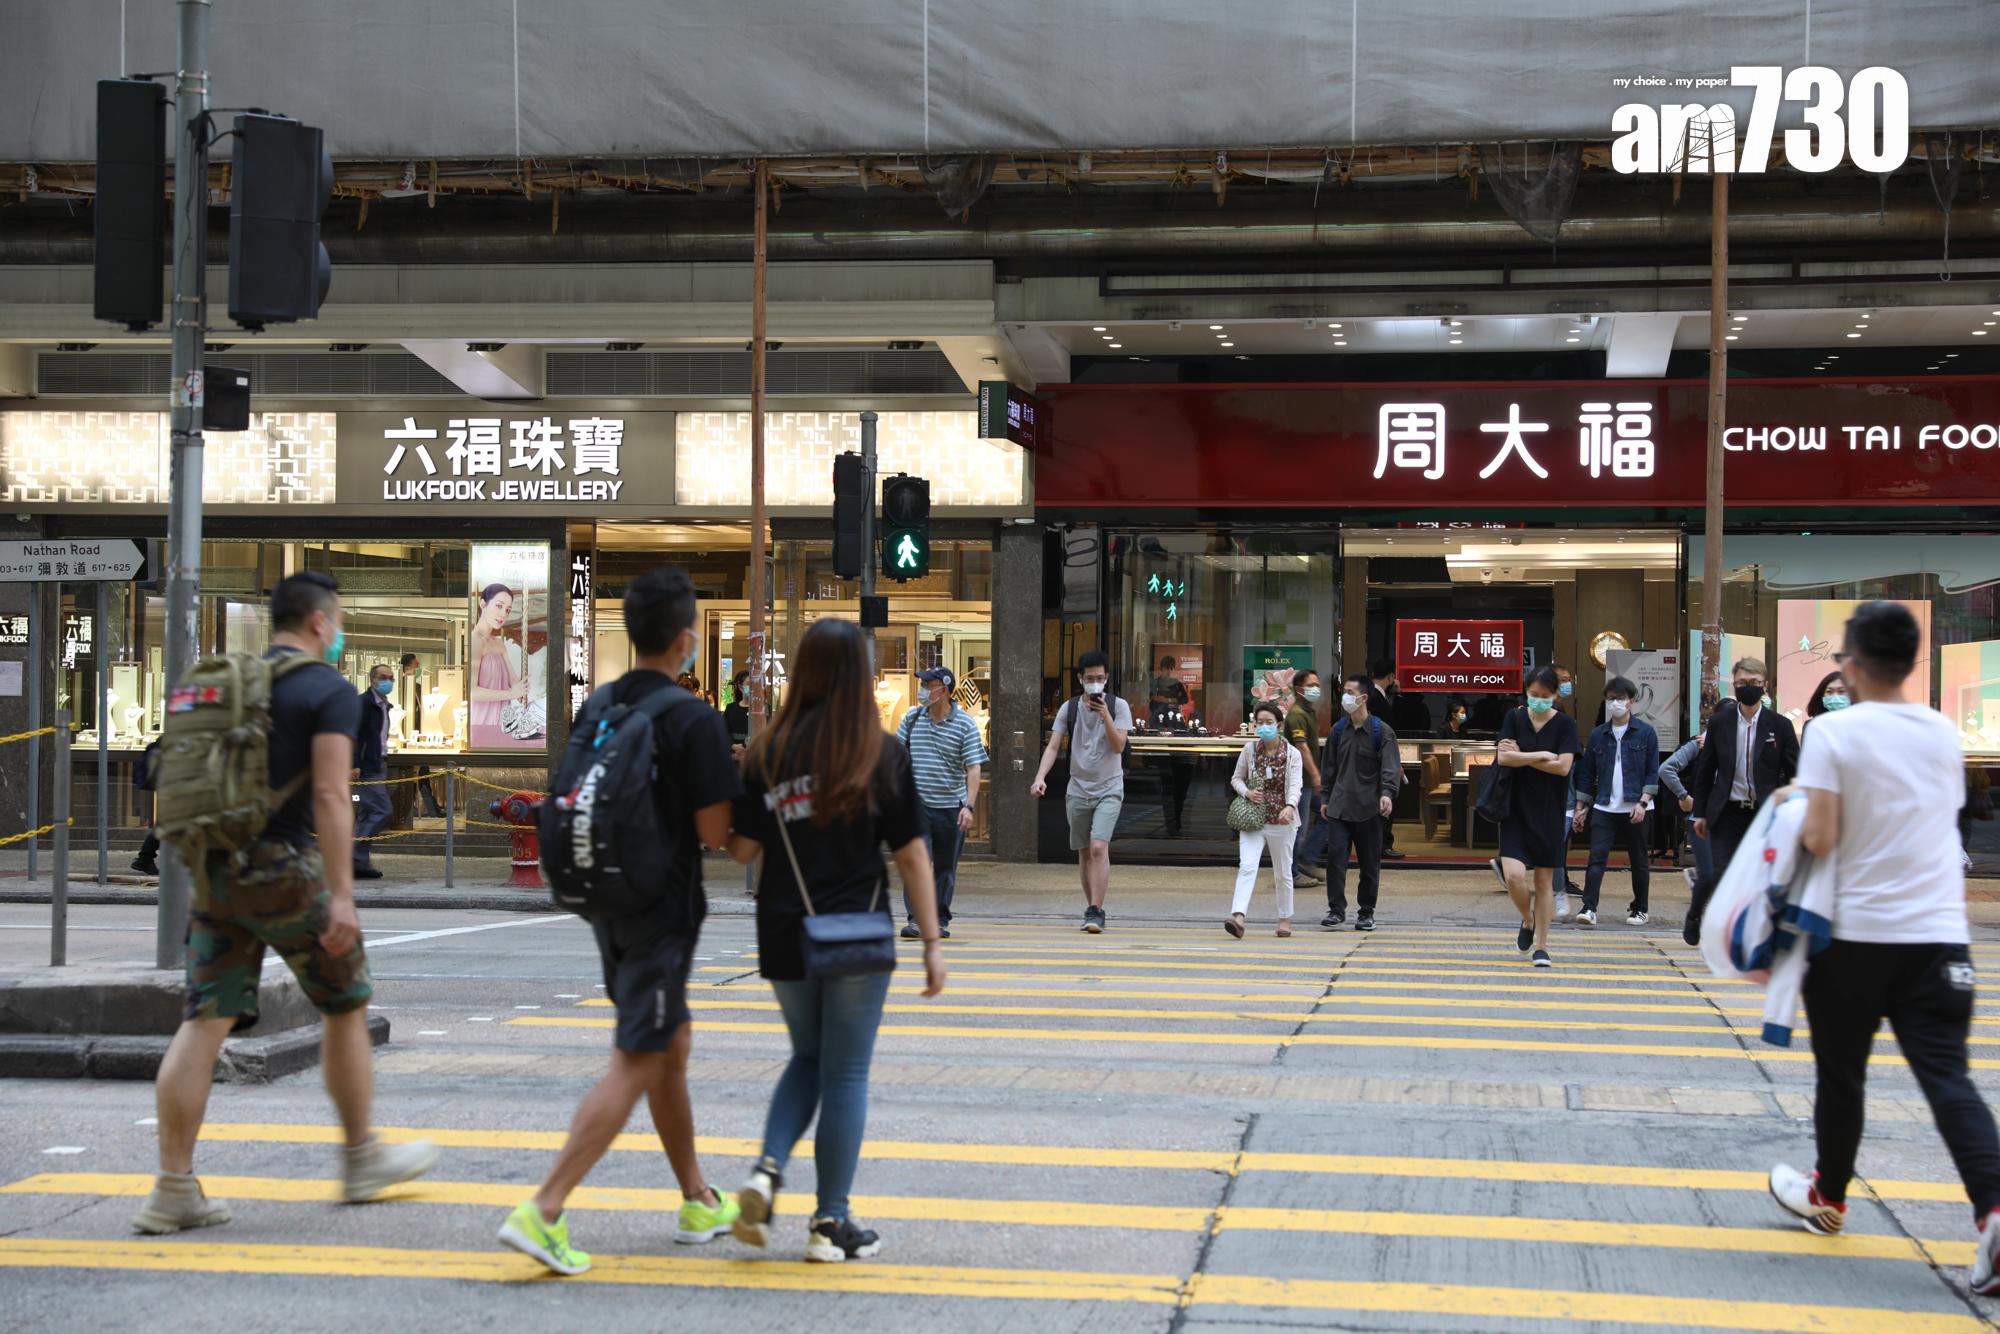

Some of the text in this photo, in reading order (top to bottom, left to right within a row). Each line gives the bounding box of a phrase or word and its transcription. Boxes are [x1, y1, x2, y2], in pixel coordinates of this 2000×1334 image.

[383, 416, 624, 476] 六福珠寶
[1373, 402, 1655, 479] 周大福
[1723, 424, 2000, 451] CHOW TAI FOO
[383, 480, 624, 500] LUKFOOK JEWELLERY
[23, 544, 101, 556] Nathan Road
[38, 562, 87, 576] 彌敦道
[1413, 631, 1505, 658] 周大福
[1264, 657, 1291, 665] ROLEX
[1413, 674, 1505, 684] CHOW TAI FOOK
